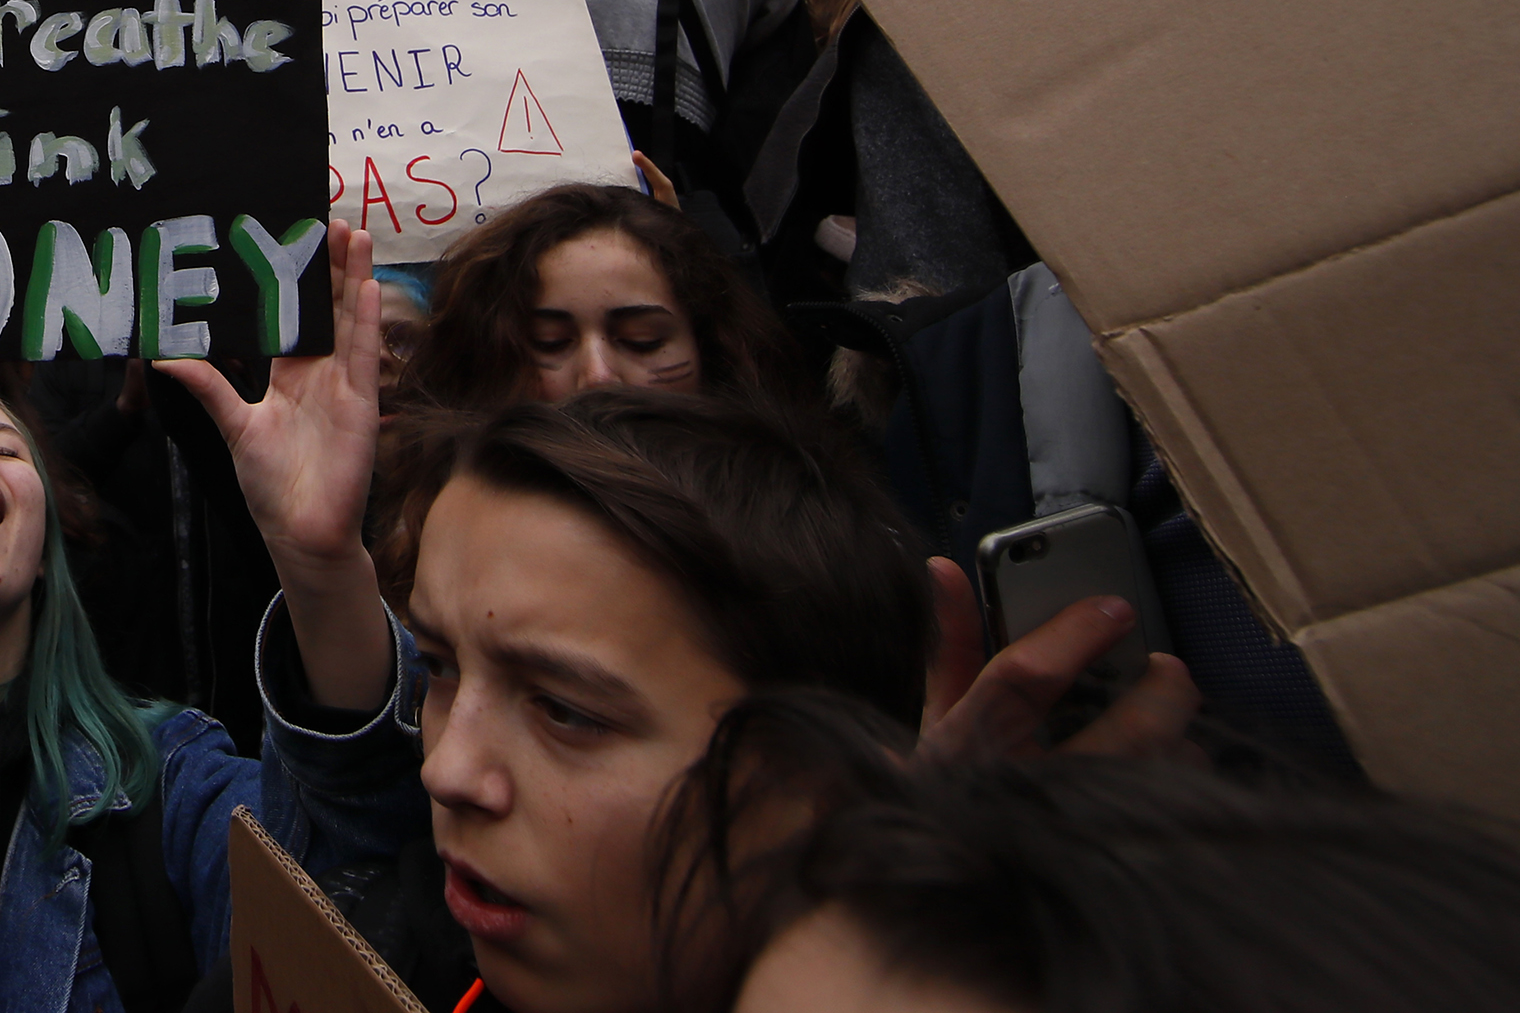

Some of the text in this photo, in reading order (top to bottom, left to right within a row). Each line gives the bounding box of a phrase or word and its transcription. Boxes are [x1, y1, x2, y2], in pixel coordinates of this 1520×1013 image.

[471, 2, 518, 17] son
[323, 44, 472, 95] ENIR
[351, 118, 405, 142] n'en
[420, 121, 444, 135] a
